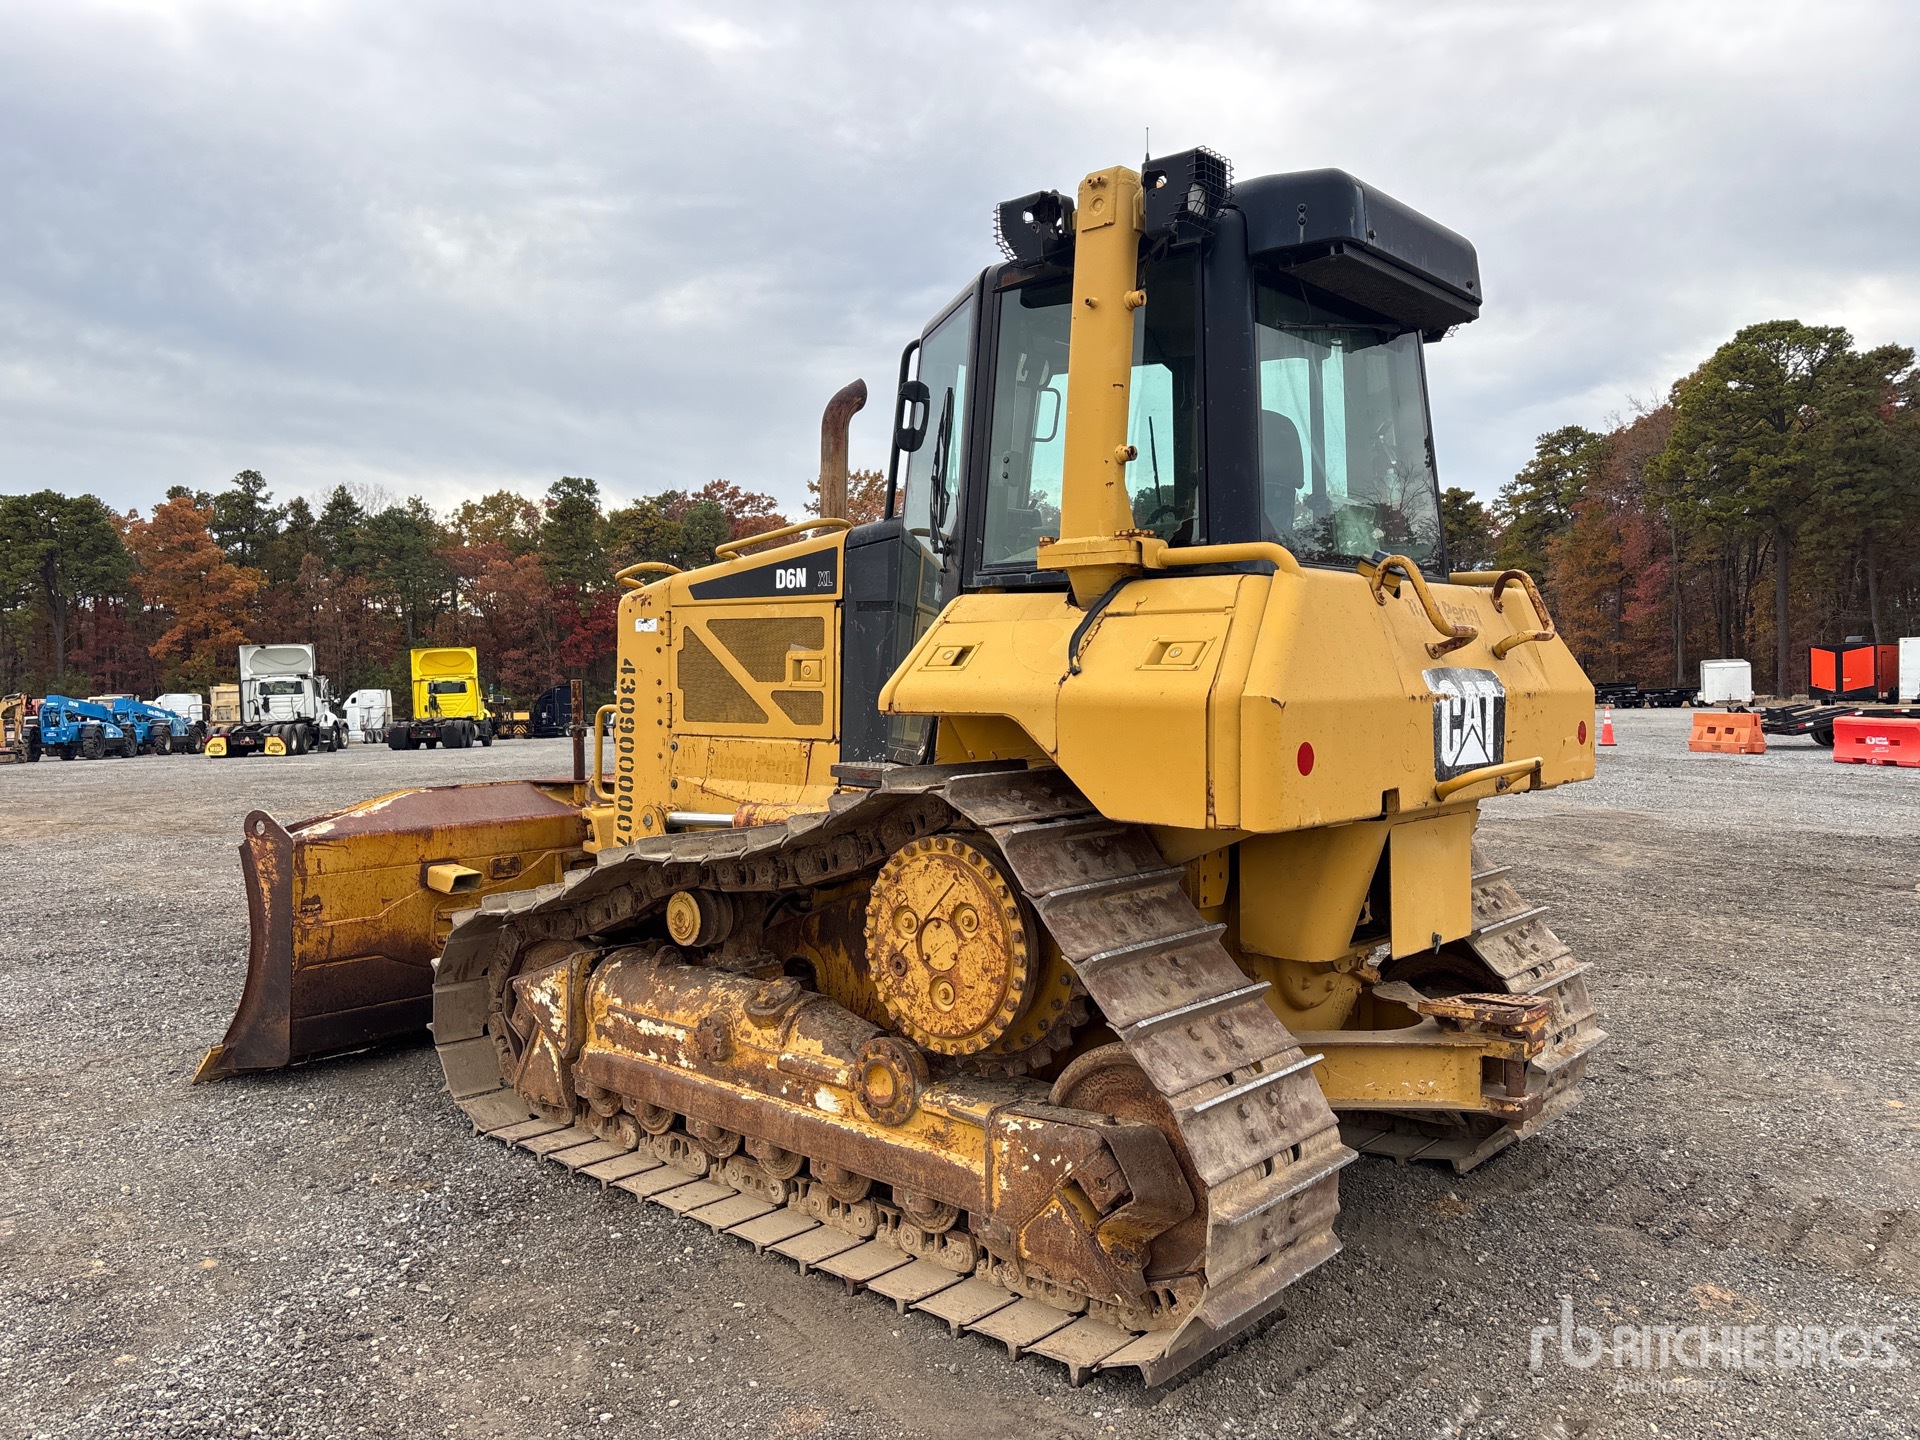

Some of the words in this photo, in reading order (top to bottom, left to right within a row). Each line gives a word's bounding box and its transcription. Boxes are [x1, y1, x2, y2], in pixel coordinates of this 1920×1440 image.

[776, 567, 807, 589] D6N
[817, 570, 834, 587] XL
[1439, 679, 1498, 767] CAT
